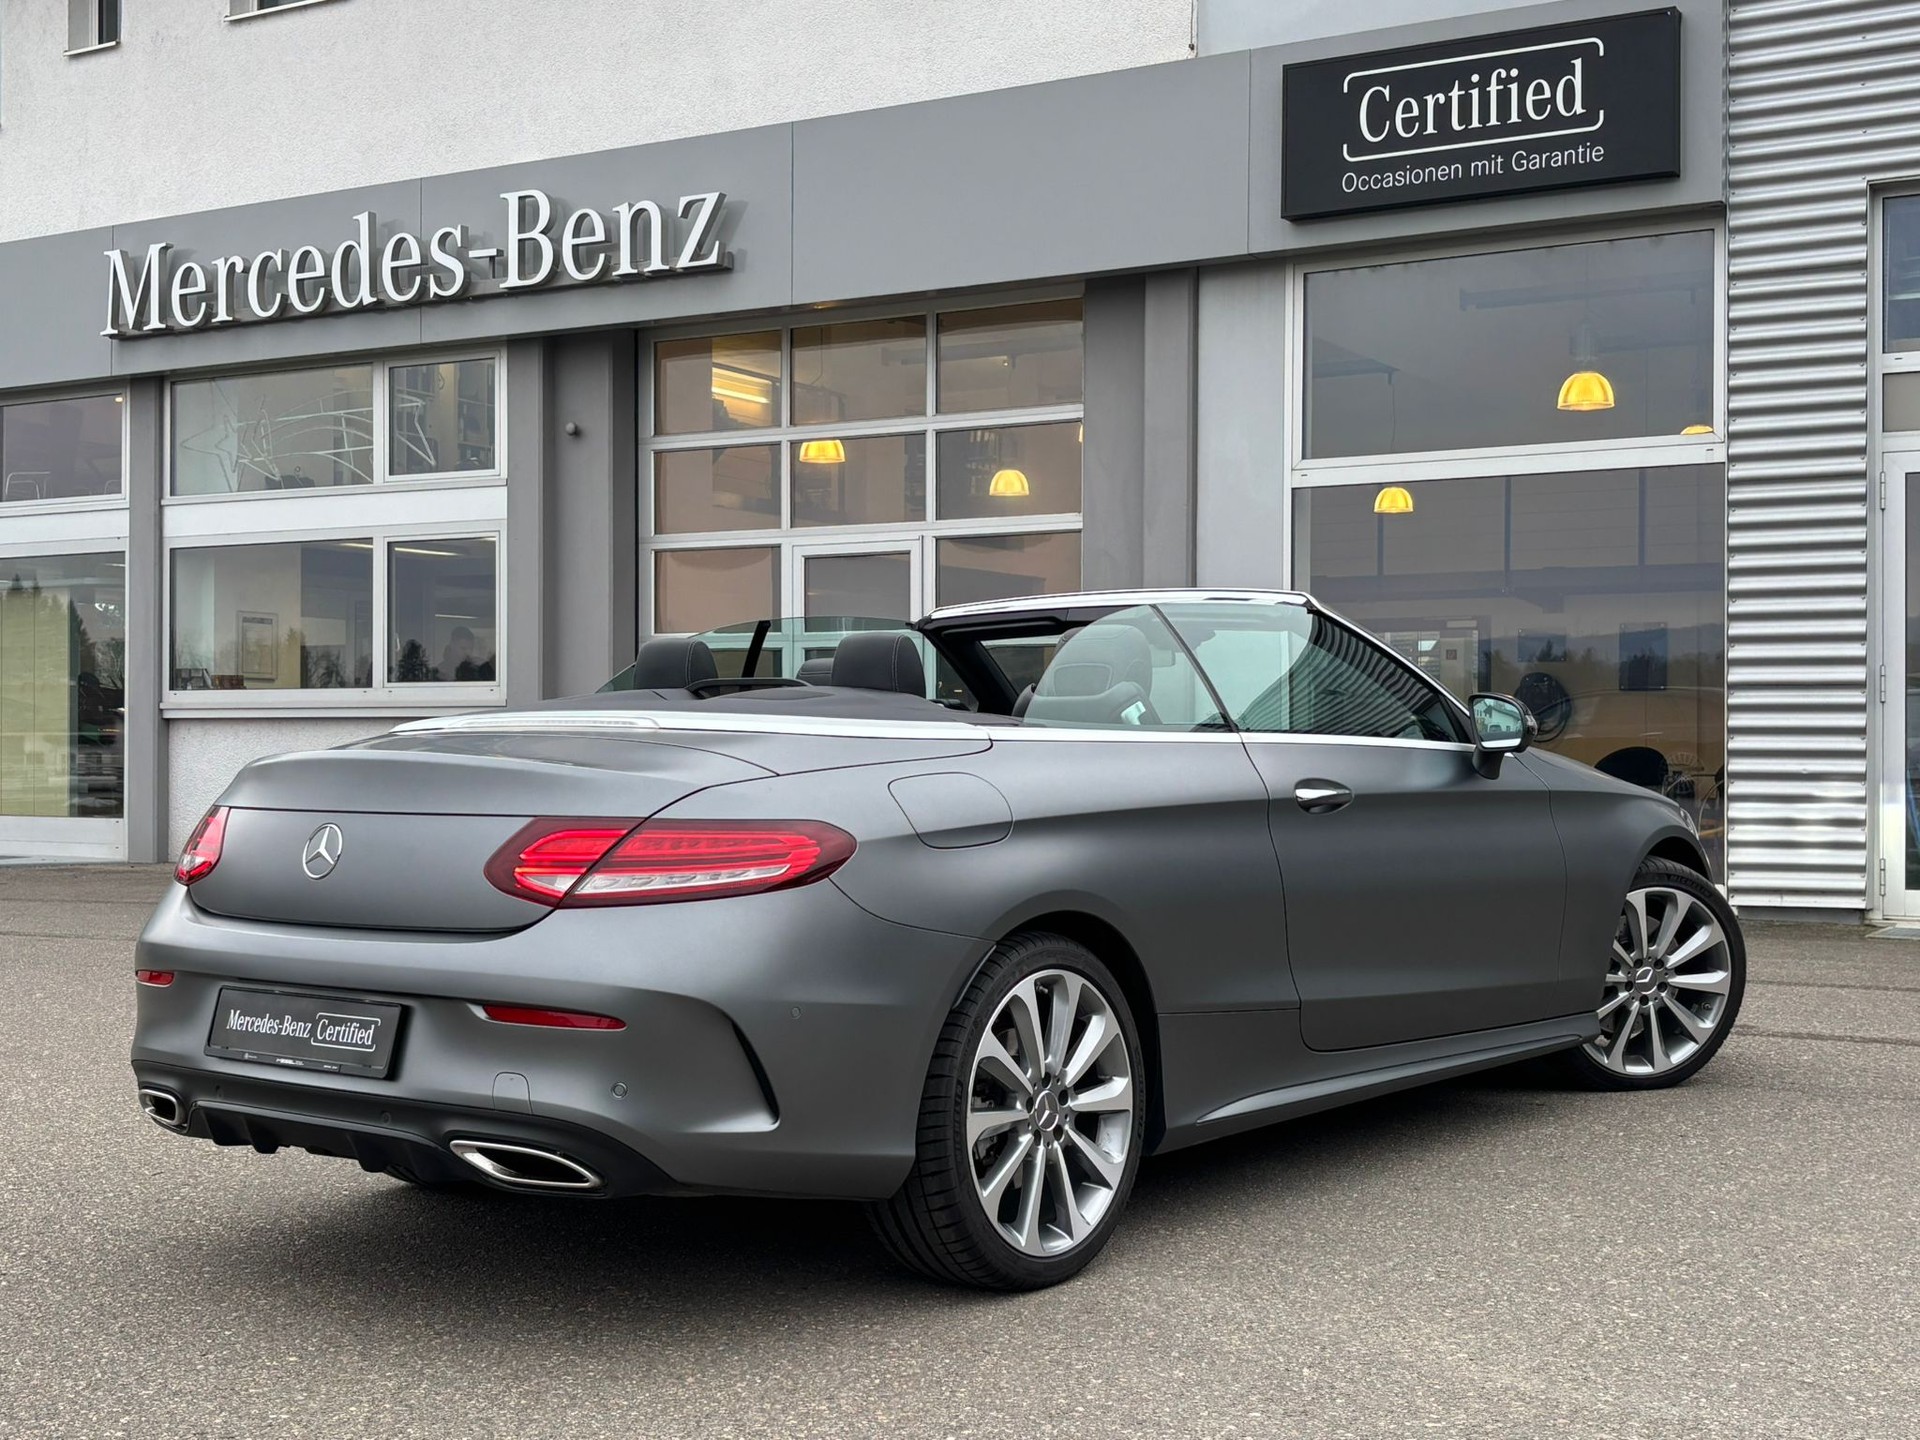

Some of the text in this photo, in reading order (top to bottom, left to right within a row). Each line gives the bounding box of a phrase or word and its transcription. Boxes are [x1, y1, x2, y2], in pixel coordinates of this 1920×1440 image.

[1359, 58, 1587, 143] Certified
[1342, 142, 1606, 193] Occasionen mit Garantie
[100, 189, 729, 336] Mercedes-Benz
[226, 1009, 376, 1045] Mercedes-Benz Certified
